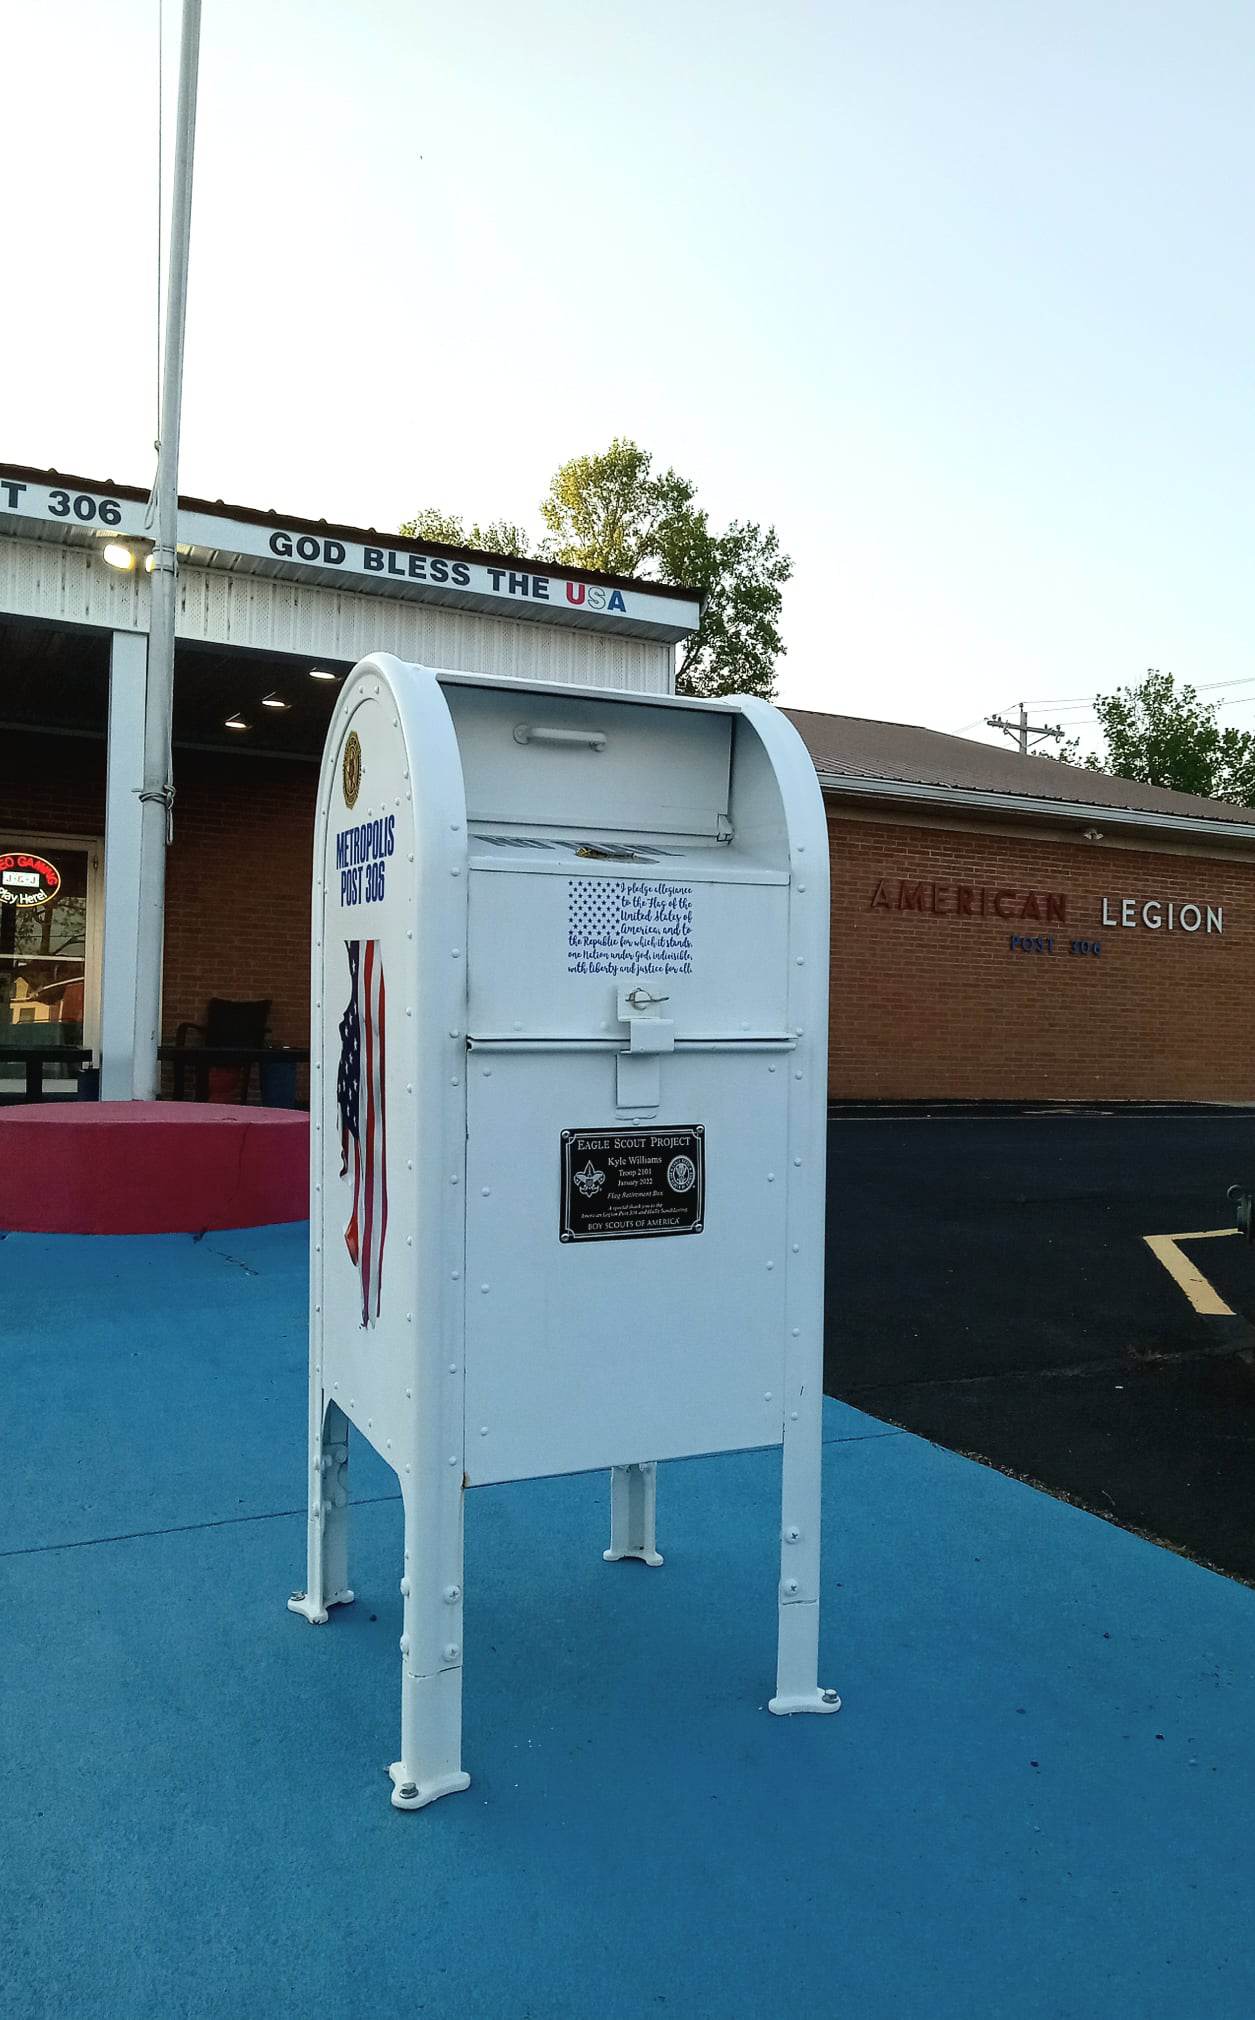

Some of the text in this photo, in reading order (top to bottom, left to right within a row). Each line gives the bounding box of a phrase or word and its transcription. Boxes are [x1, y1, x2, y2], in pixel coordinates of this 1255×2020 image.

[48, 490, 122, 526] 306
[268, 531, 627, 613] GOD BLESS THE USA
[336, 814, 395, 870] METROPOLIS
[341, 860, 385, 907] POST 306
[620, 882, 693, 897] I pledge allegiance
[19, 888, 48, 904] Here!
[621, 896, 692, 910] to the Flag of the
[870, 879, 1224, 935] AMERICAN LEGION
[620, 909, 693, 923] United States of
[662, 923, 681, 936] and
[682, 923, 692, 936] to
[568, 935, 582, 947] the
[582, 935, 619, 949] Republic
[620, 936, 633, 948] for
[634, 936, 656, 948] which
[657, 937, 665, 947] it
[1011, 934, 1055, 956] POST
[568, 950, 582, 960] one
[582, 949, 609, 960] Nation
[610, 949, 634, 960] under
[568, 962, 588, 974] with
[589, 962, 618, 976] liberty
[619, 962, 636, 974] and
[636, 962, 664, 976] justice
[664, 962, 678, 975] for
[608, 1156, 662, 1167] Kyle Williams
[618, 1169, 637, 1178] Troop
[618, 1180, 638, 1188] January
[588, 1217, 680, 1231] BOY SCOUTS OF AMERICA
